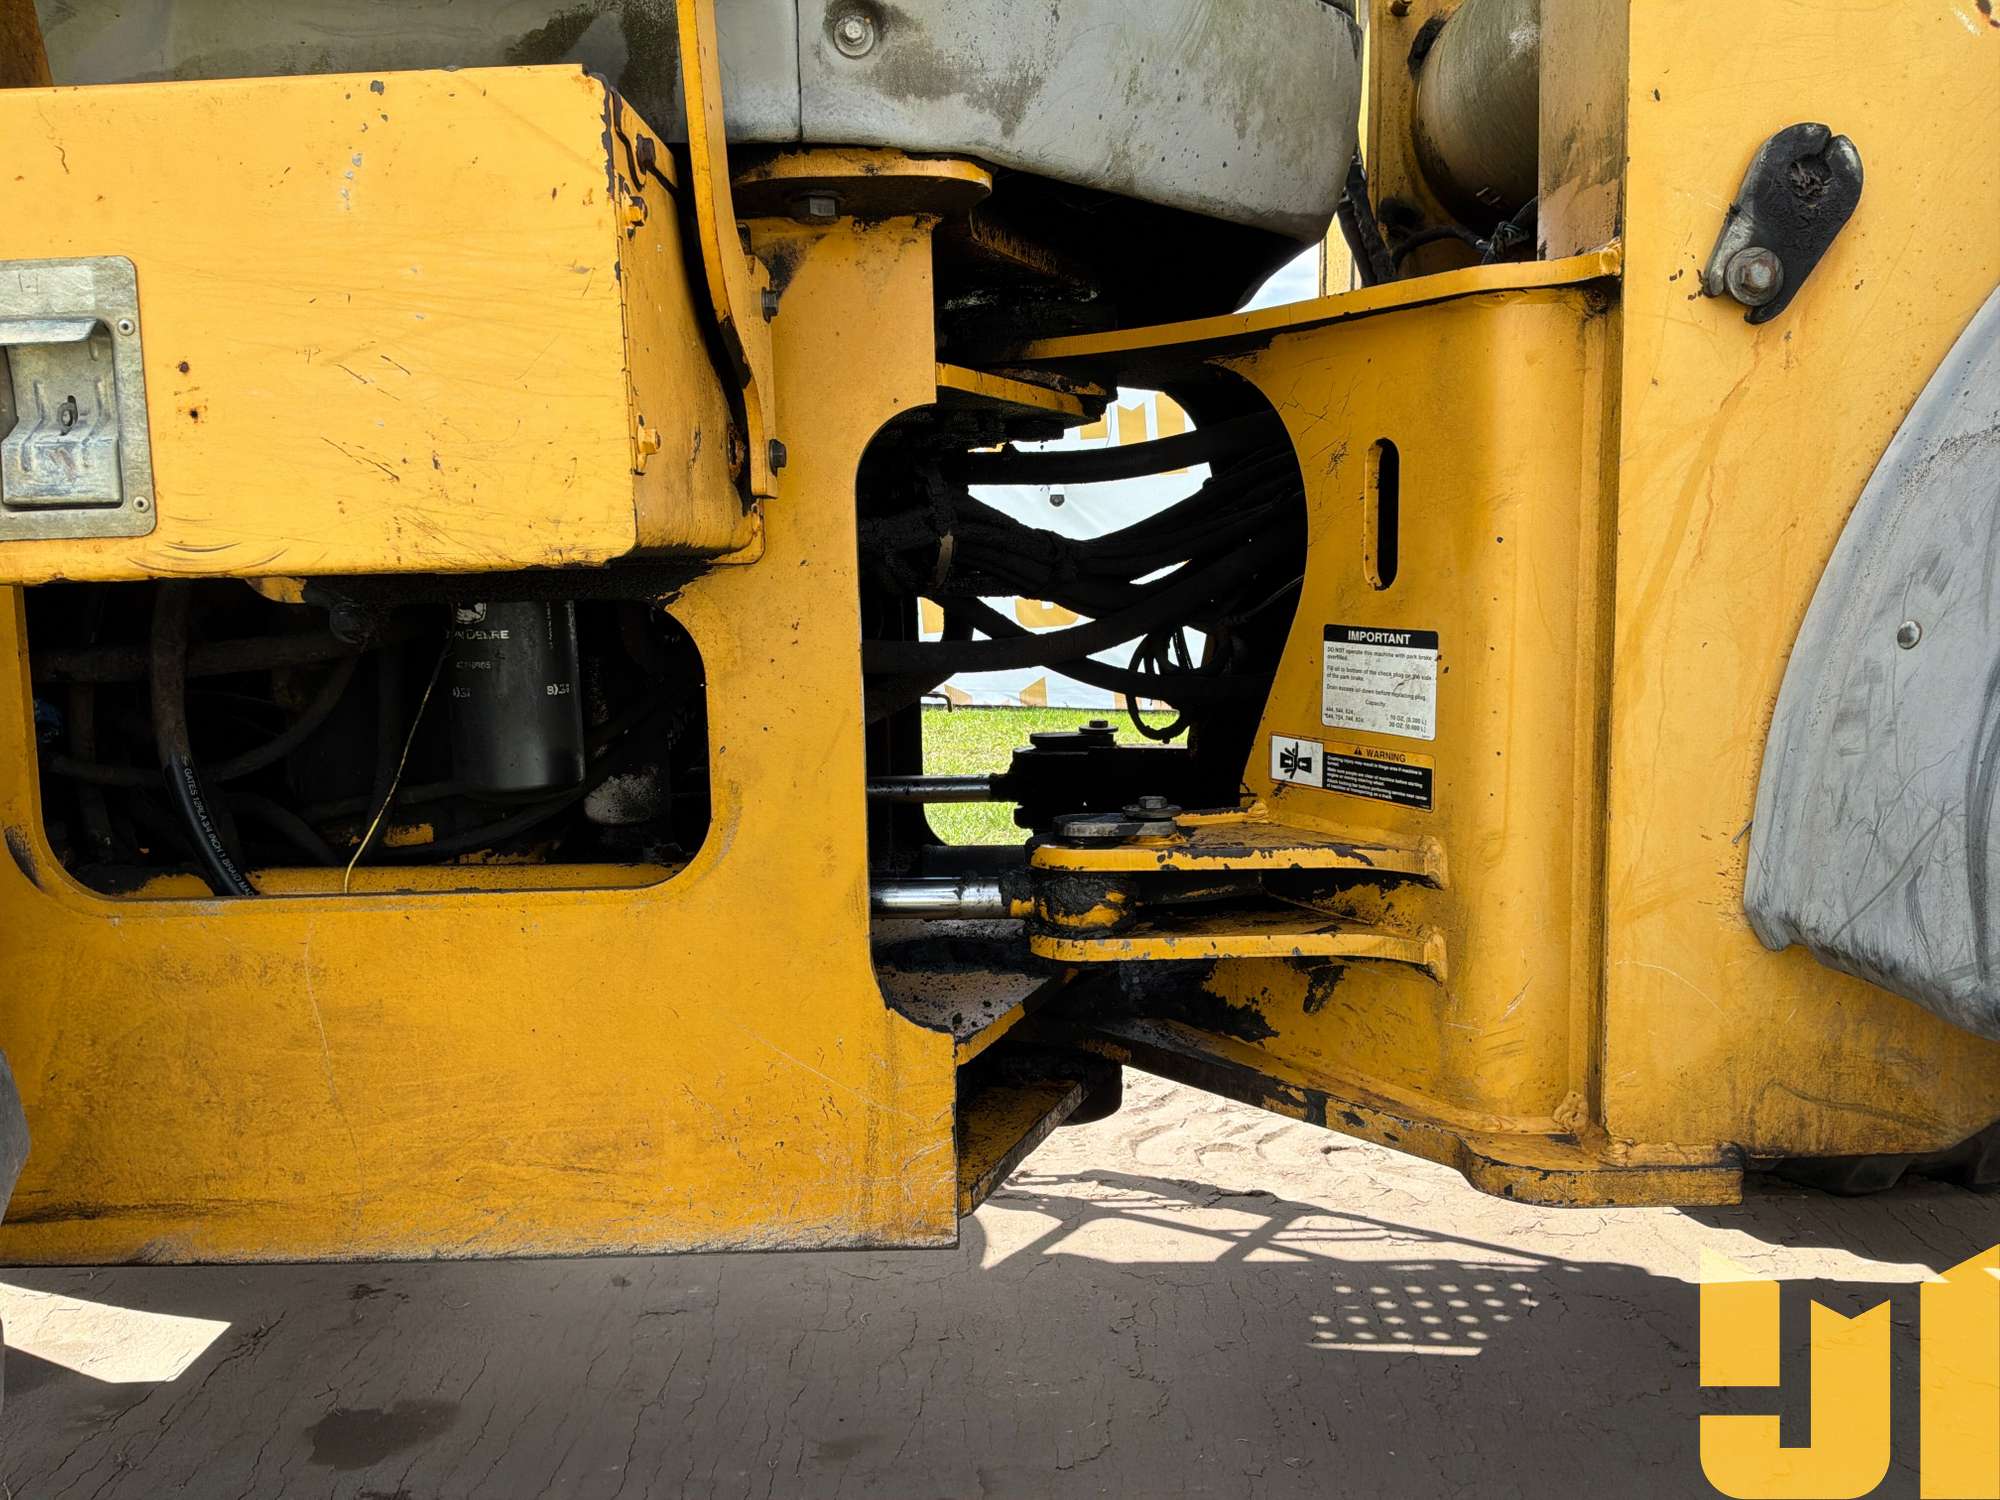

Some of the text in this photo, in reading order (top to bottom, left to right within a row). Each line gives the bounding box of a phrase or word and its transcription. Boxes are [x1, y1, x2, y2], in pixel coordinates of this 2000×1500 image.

[1348, 630, 1411, 645] IMPORTANT
[1366, 749, 1406, 763] WARNING
[184, 768, 199, 797] GATES
[208, 833, 224, 853] INCH
[222, 858, 242, 882] BRAID
